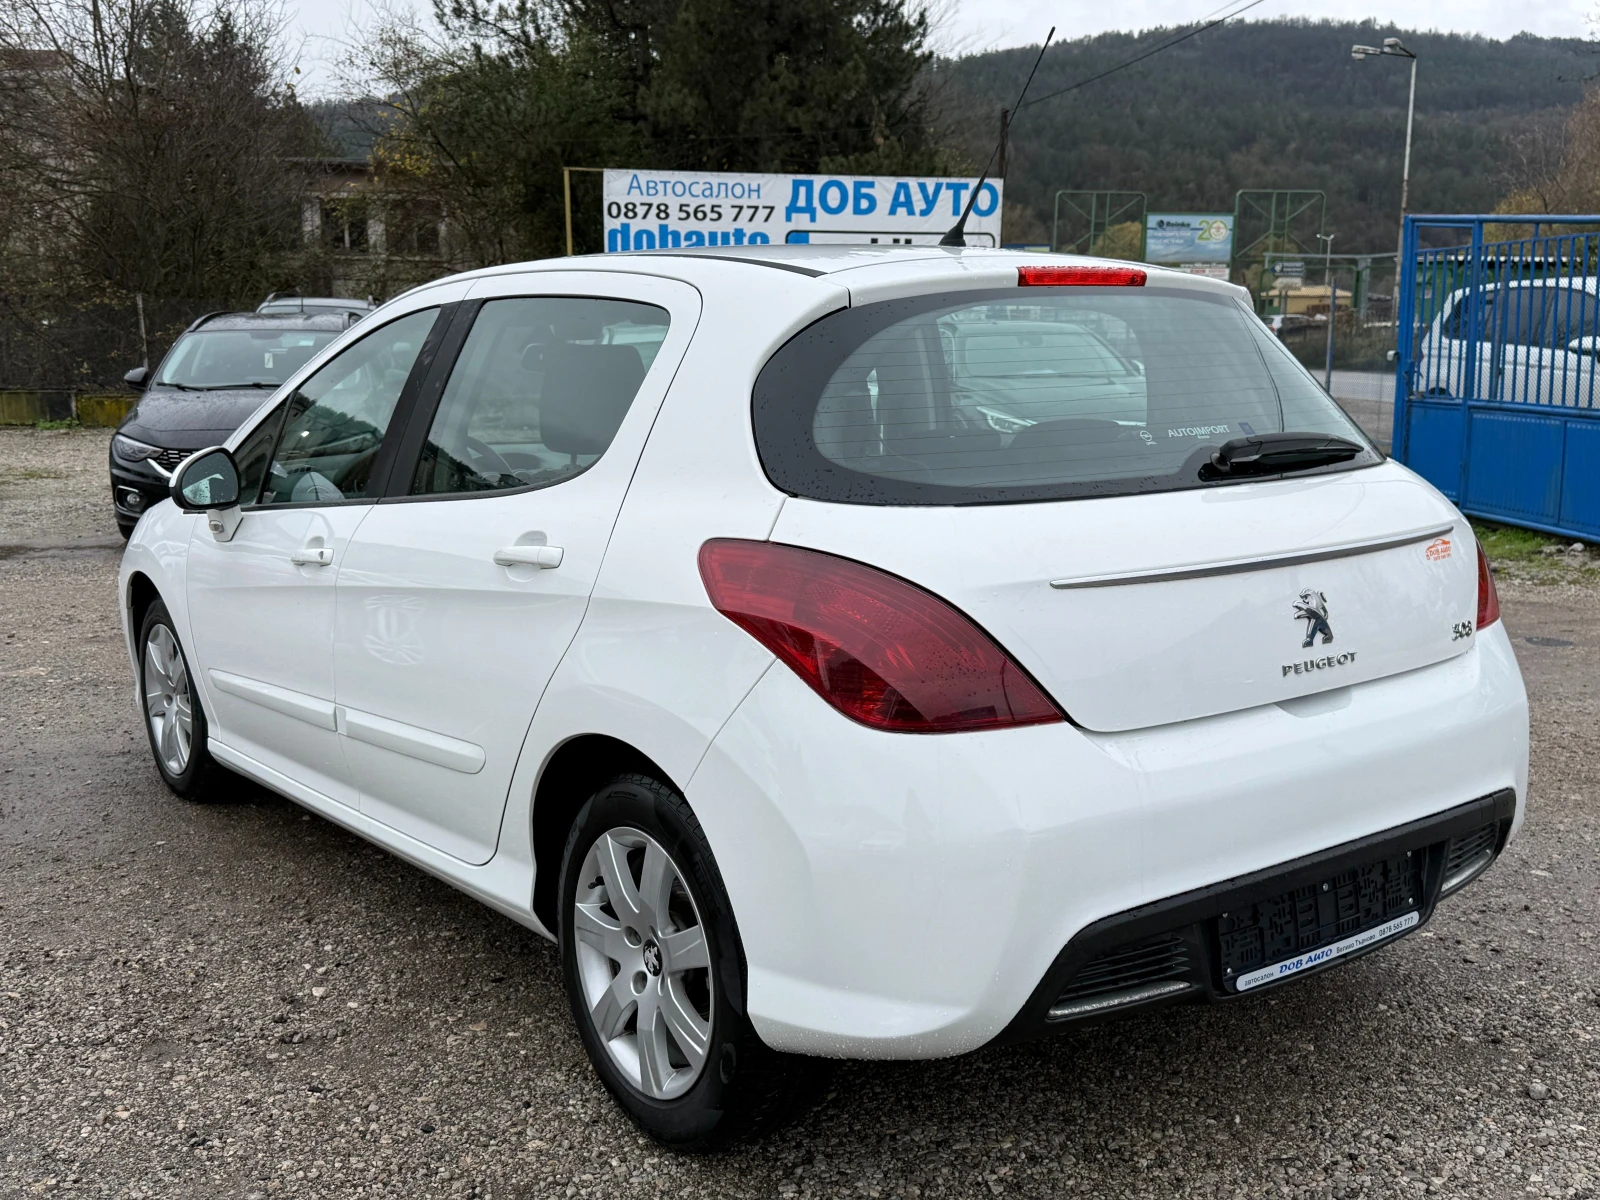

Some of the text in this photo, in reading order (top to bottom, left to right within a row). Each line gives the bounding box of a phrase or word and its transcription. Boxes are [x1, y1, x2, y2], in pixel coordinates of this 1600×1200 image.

[627, 173, 761, 199] Автосалон
[607, 201, 775, 223] 0878 565 777
[785, 179, 999, 223] ДОБ АУТО
[1168, 424, 1230, 438] AUTOIMPORT
[1452, 620, 1472, 641] 308
[1282, 651, 1357, 677] PEUGEOT
[1244, 972, 1274, 986] автосалон
[1279, 959, 1303, 974] DOB
[1336, 943, 1355, 954] Велико
[1379, 926, 1393, 937] 0878
[1393, 920, 1403, 931] 565
[1403, 916, 1414, 926] 777
